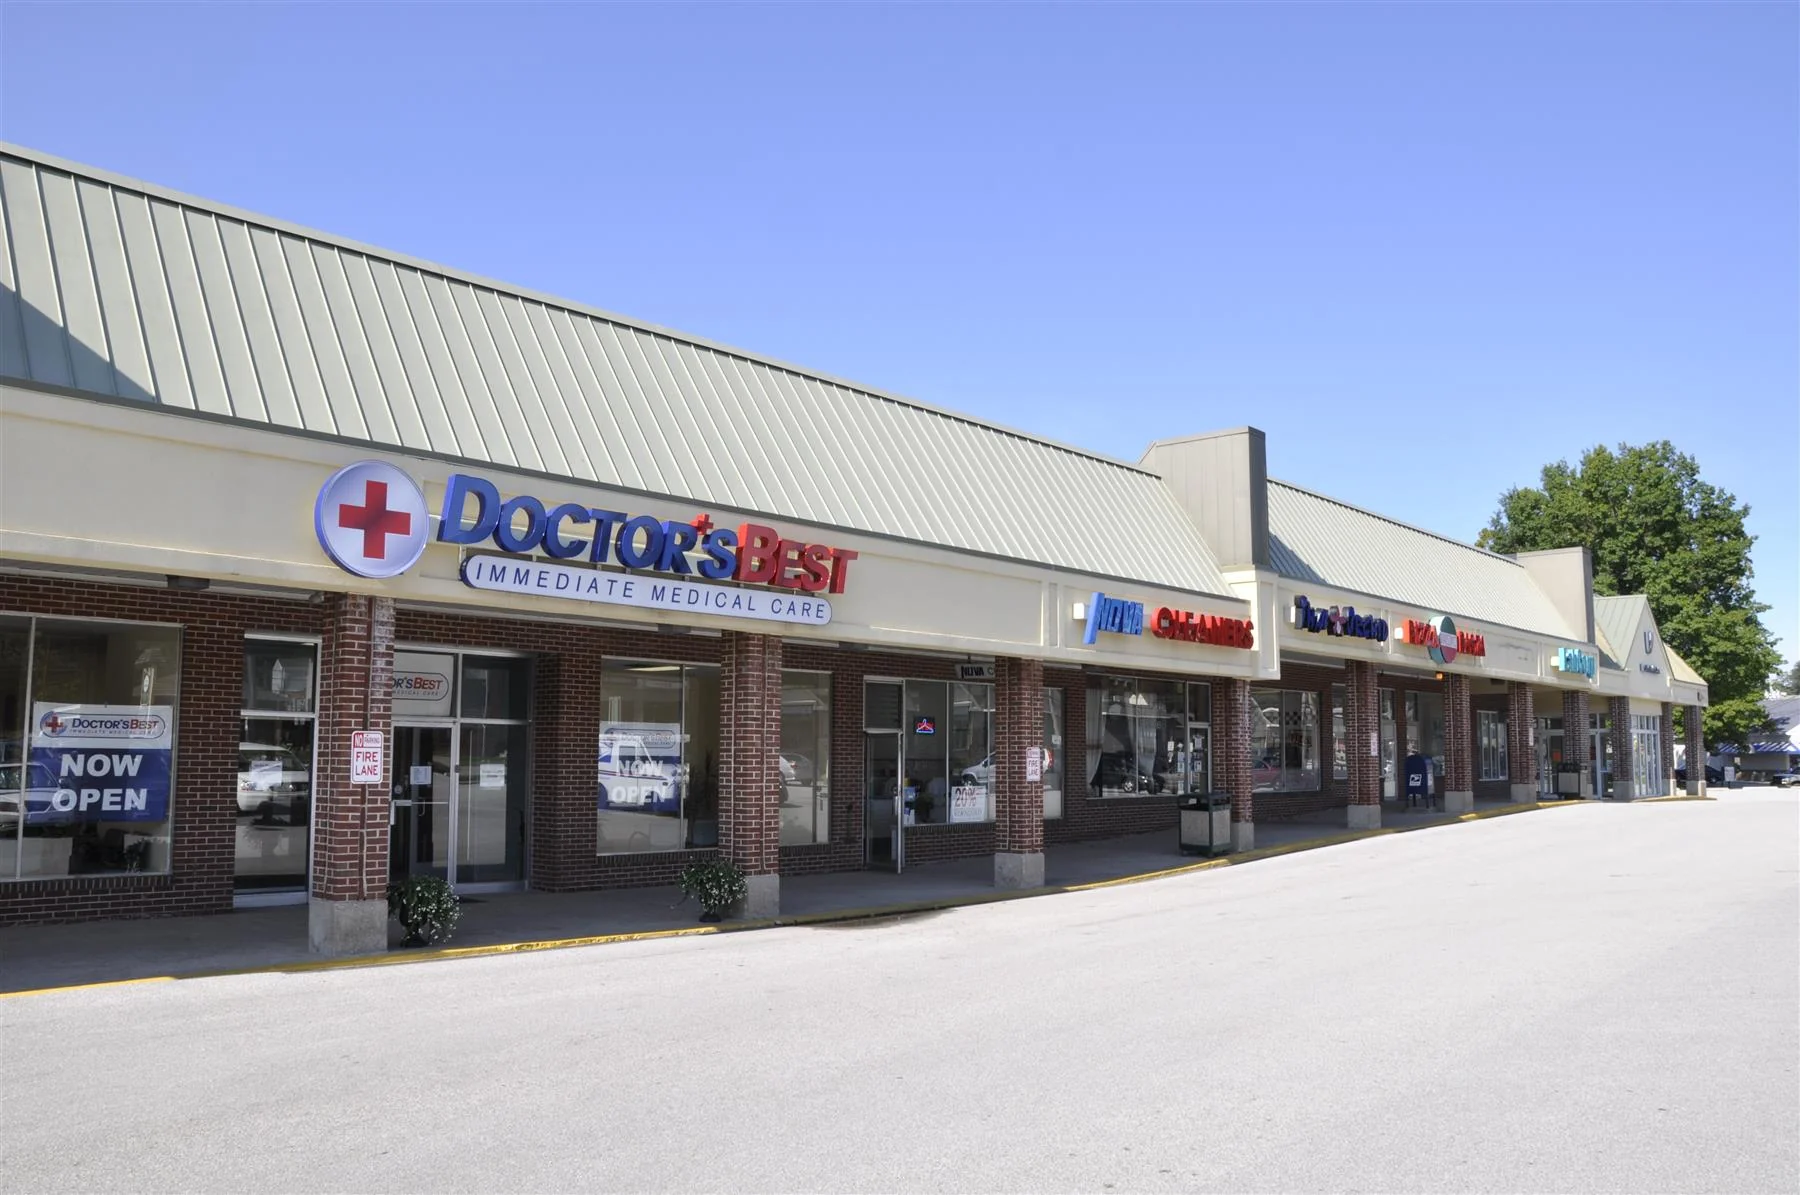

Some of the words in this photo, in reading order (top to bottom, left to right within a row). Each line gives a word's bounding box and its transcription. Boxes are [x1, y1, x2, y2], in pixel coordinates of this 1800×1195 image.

[475, 561, 635, 599] IMMEDIATE
[652, 585, 756, 612] MEDICAL
[771, 597, 826, 621] CARE
[1083, 591, 1144, 645] NOVA
[1151, 606, 1255, 650] CLEANERS
[60, 754, 143, 777] NOW
[356, 751, 379, 762] FIRE
[355, 765, 379, 776] LANE
[619, 759, 664, 777] NOW
[51, 788, 147, 812] OPEN
[611, 786, 665, 803] OPEN
